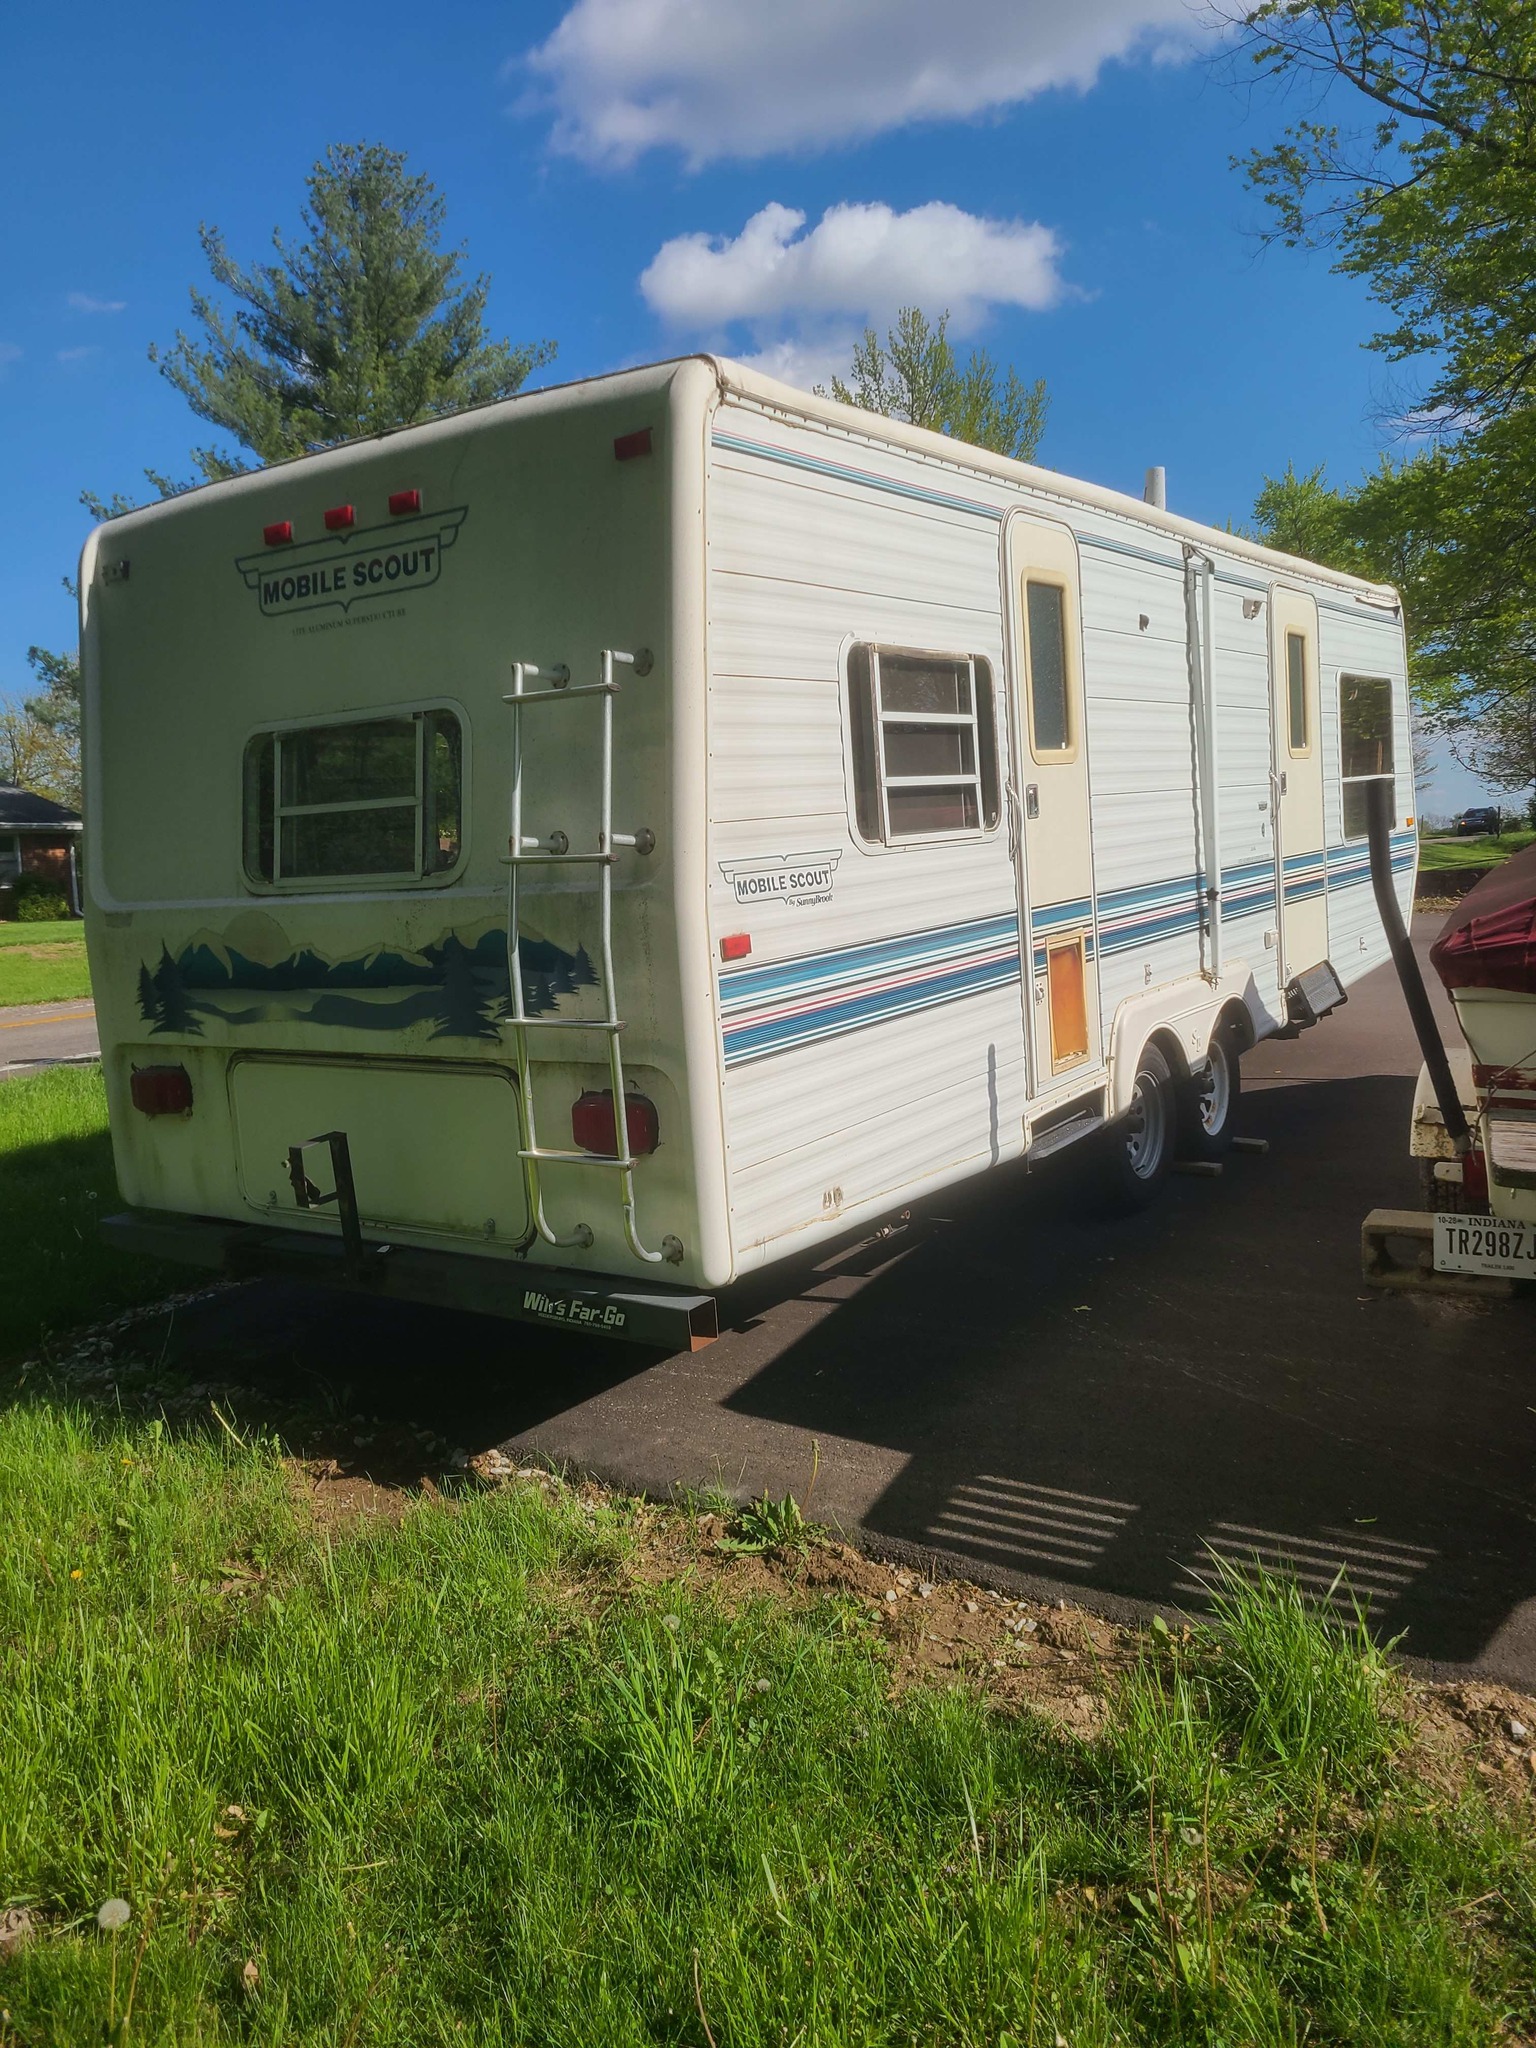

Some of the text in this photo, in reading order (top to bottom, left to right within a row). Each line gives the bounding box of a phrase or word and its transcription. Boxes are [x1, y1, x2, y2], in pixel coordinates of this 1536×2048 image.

[263, 547, 435, 605] MOBILE SCOUT
[737, 869, 829, 896] MOBILE SCOUT
[796, 893, 833, 907] SunnyBrook
[1468, 1217, 1526, 1229] INDIANA
[1446, 1227, 1536, 1260] TR298ZJ
[569, 1300, 625, 1326] Far-Go
